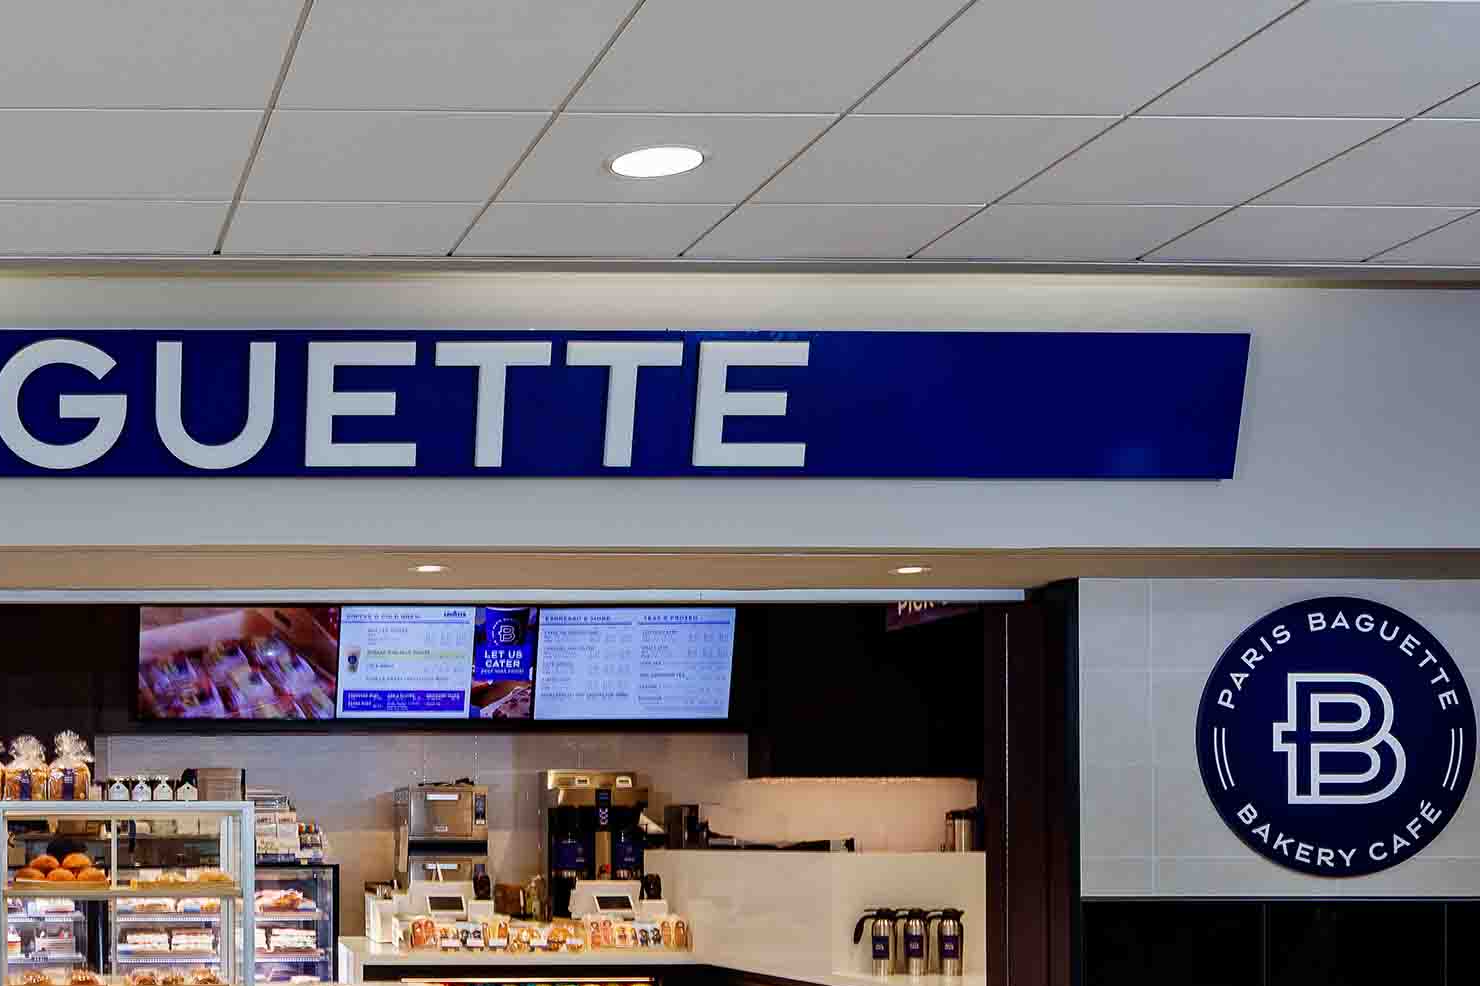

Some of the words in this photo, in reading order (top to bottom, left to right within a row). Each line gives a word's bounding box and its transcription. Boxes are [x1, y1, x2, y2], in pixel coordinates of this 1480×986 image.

[484, 650, 506, 660] LET
[508, 650, 523, 660] US
[485, 660, 521, 669] CATER
[1217, 624, 1291, 710] PARIS
[1308, 610, 1460, 711] BAGUETTE
[1237, 803, 1357, 867] BAKERY
[1368, 799, 1443, 861] CAFÉ
